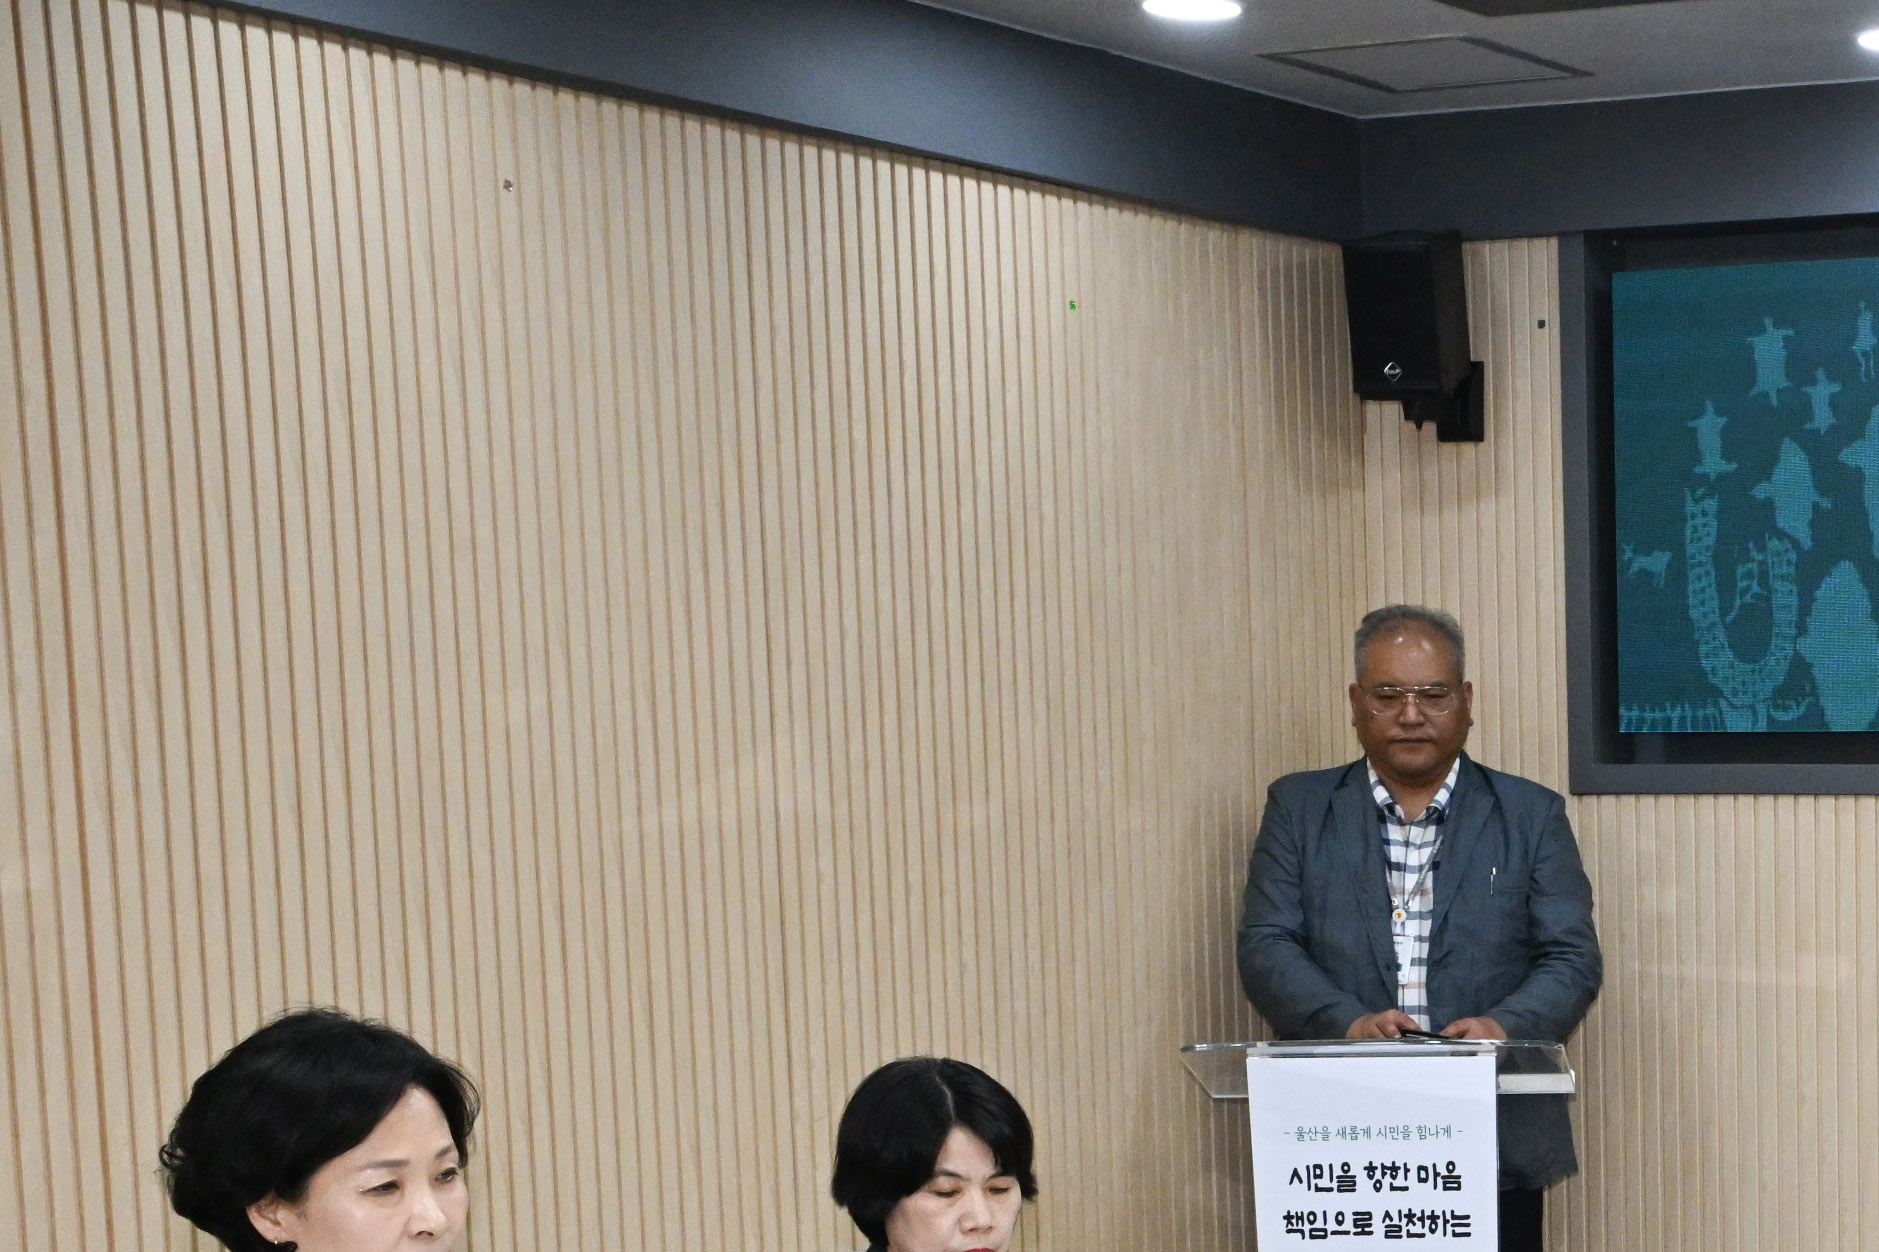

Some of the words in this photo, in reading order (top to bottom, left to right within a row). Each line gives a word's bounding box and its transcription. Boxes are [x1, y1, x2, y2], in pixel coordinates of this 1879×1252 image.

[1295, 1126, 1330, 1141] 울산을
[1336, 1126, 1371, 1140] 새롭게
[1377, 1125, 1412, 1140] 시민을
[1417, 1125, 1451, 1140] 힘나게
[1289, 1162, 1356, 1193] 시민을
[1364, 1161, 1410, 1192] 향한
[1417, 1161, 1461, 1191] 마음
[1283, 1210, 1373, 1240] 책임으로
[1382, 1208, 1471, 1239] 실천하는
